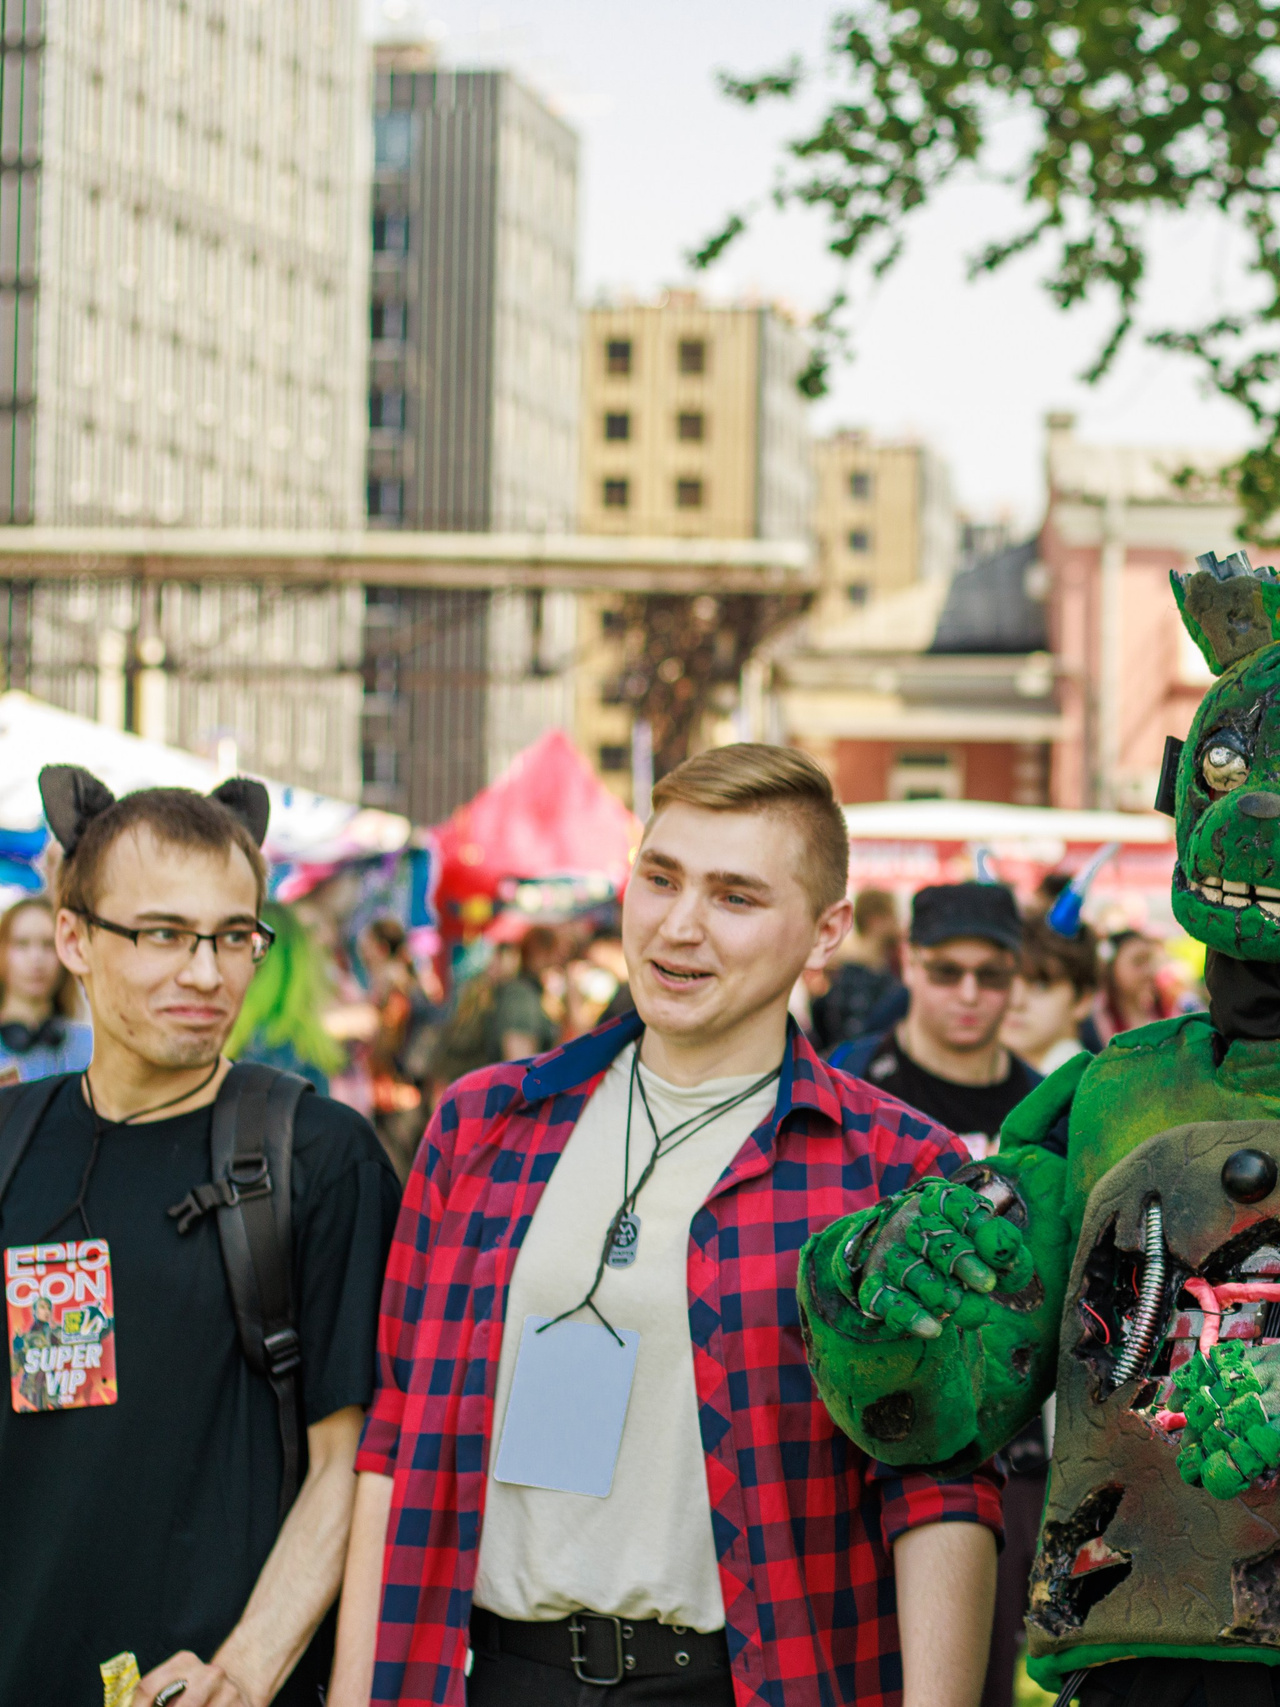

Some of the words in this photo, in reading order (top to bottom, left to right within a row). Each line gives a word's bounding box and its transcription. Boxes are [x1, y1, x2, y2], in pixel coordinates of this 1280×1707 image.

[7, 1240, 108, 1276] EPIC
[6, 1270, 106, 1308] CON
[24, 1343, 103, 1373] SUPER
[46, 1369, 87, 1396] VIP
